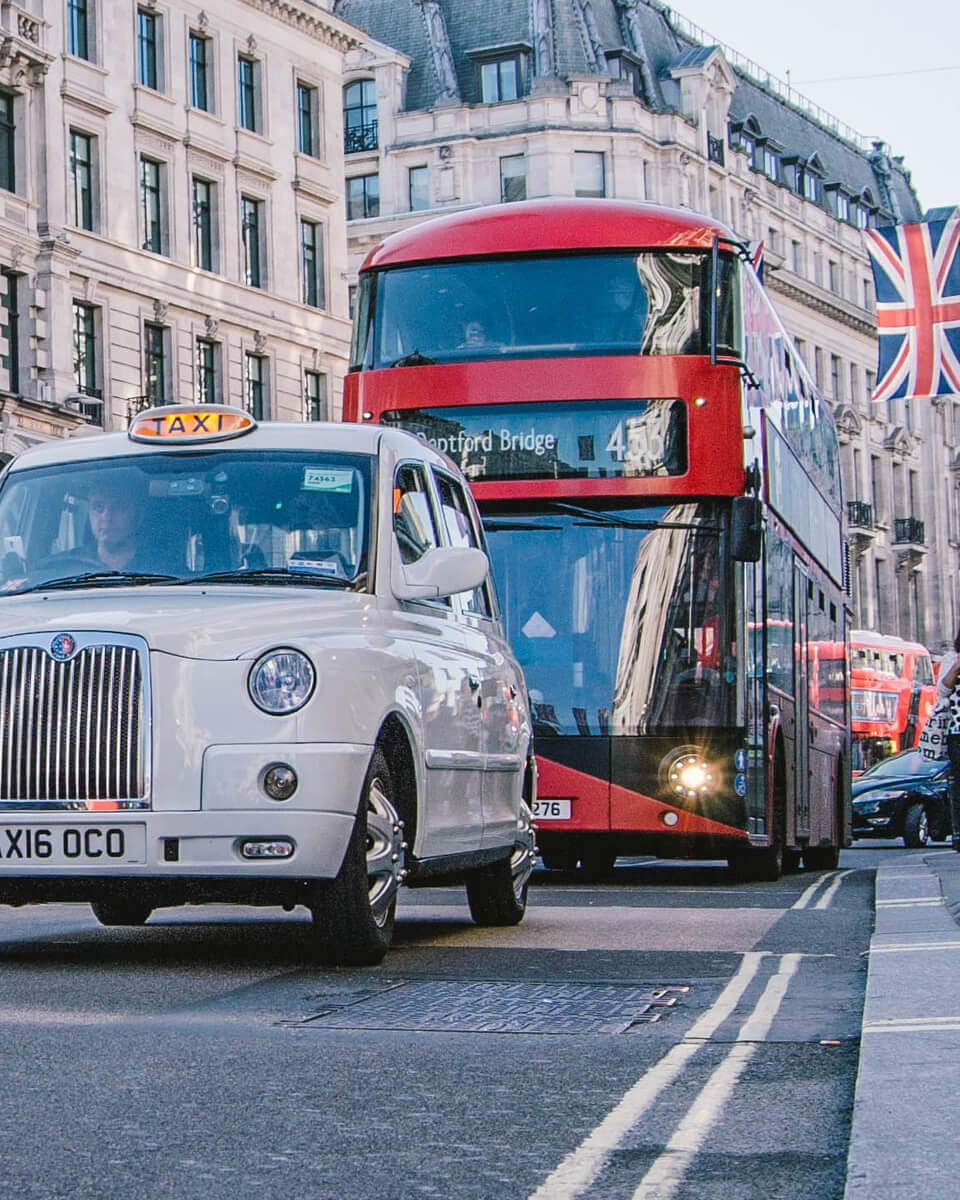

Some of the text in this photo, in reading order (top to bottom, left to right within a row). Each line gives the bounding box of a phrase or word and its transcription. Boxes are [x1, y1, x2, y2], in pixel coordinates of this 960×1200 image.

[152, 415, 223, 436] TAXI
[500, 427, 555, 456] Bridge
[63, 828, 125, 858] OCO
